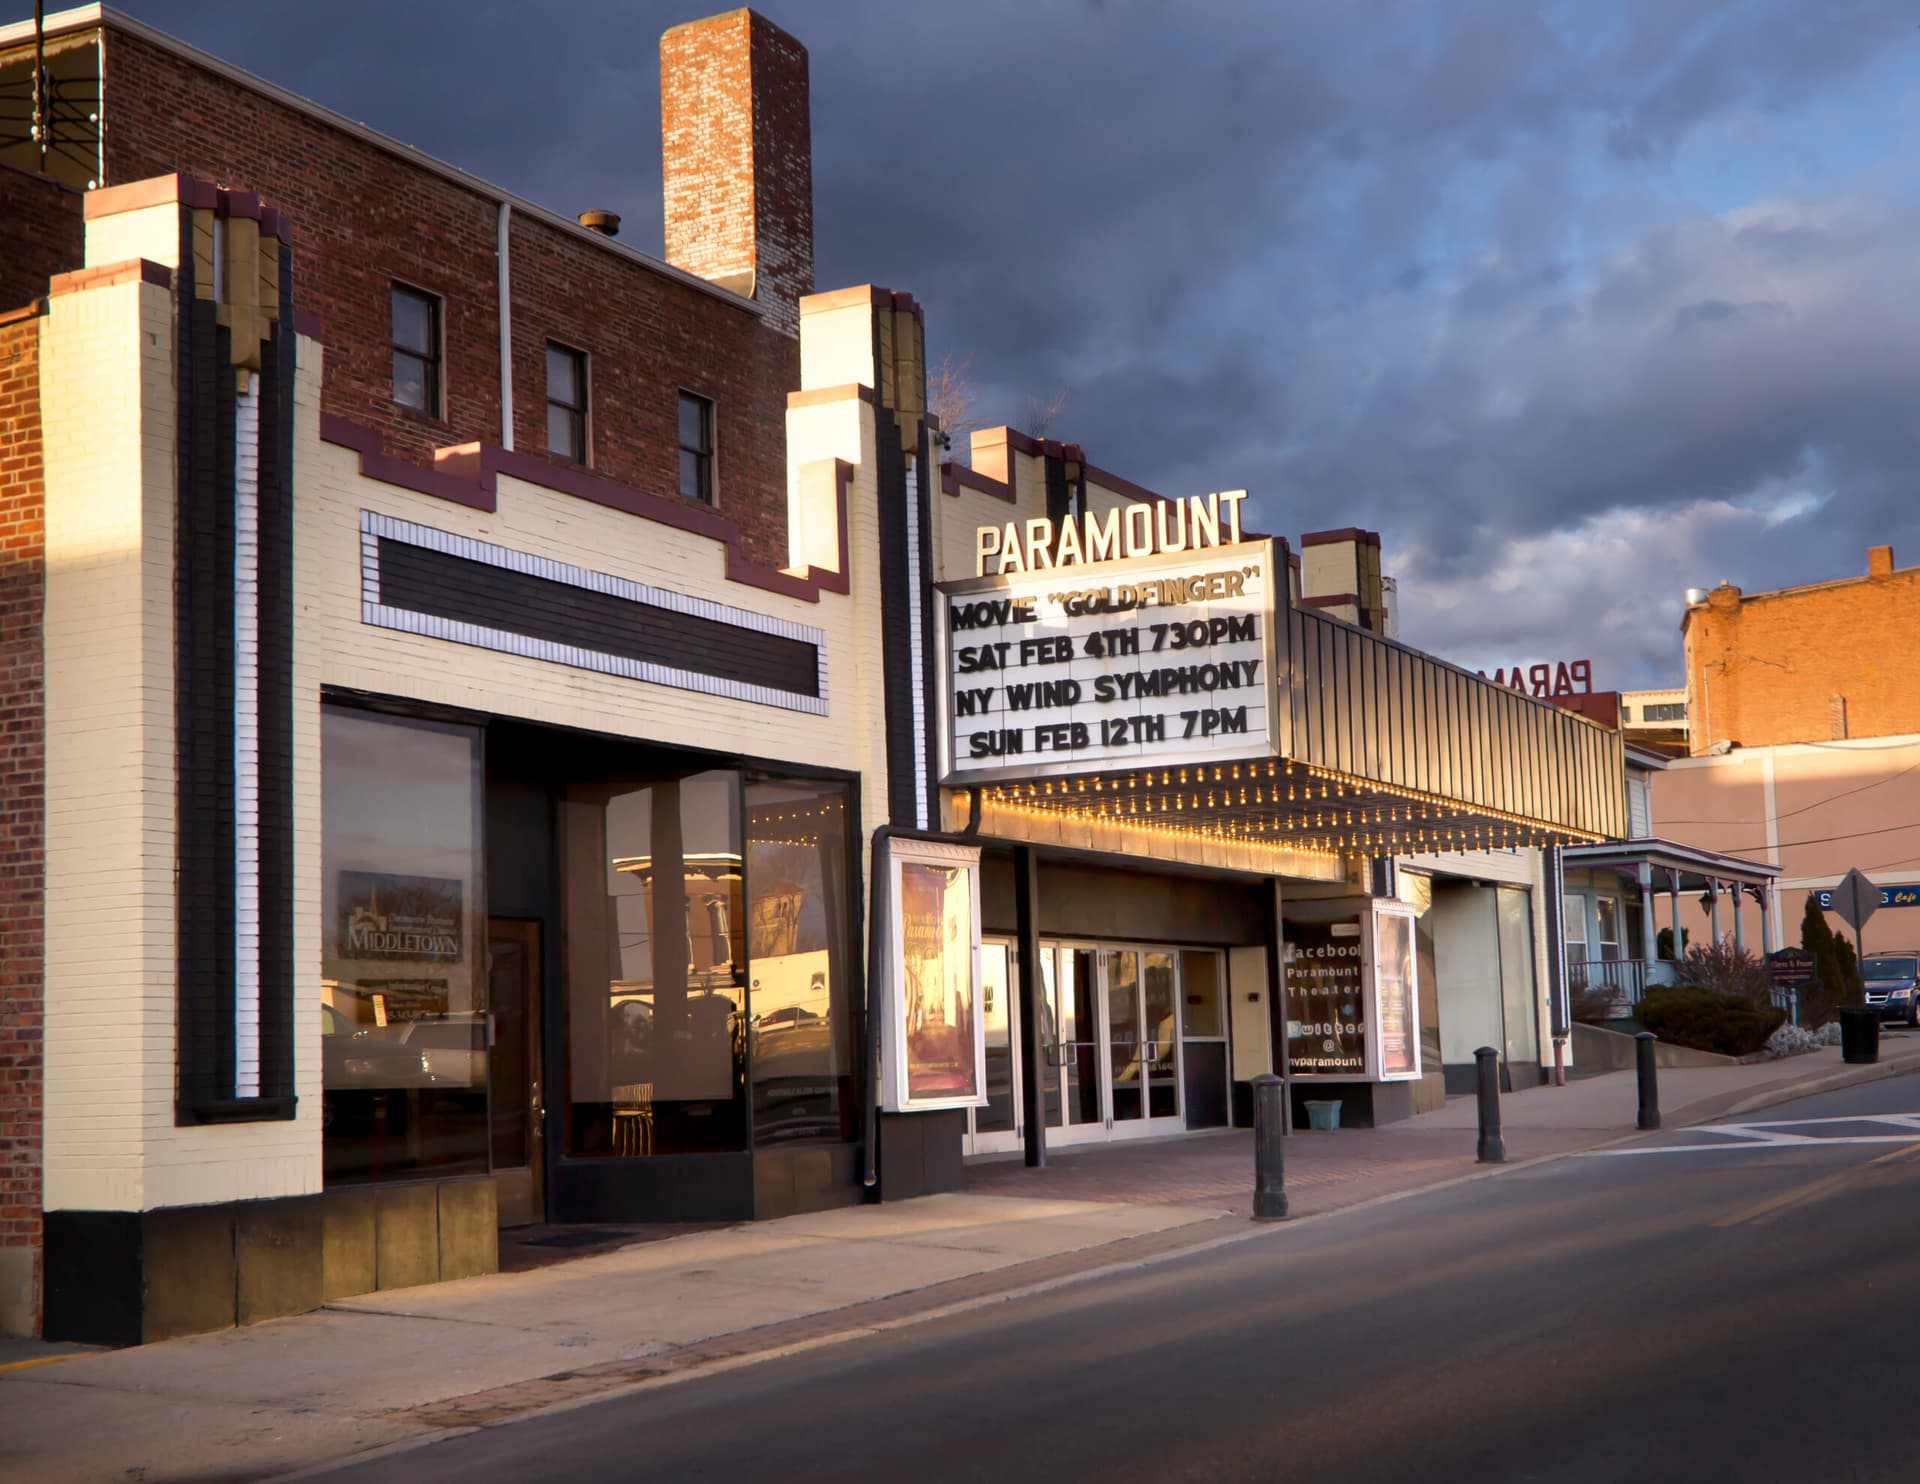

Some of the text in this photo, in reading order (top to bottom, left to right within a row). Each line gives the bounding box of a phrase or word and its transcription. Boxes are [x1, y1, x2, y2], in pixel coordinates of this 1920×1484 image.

[976, 489, 1248, 577] PARAMOUNT
[951, 597, 1037, 631] MOVIE
[958, 613, 1255, 673] SAT FEB 4TH 730PM
[956, 659, 1260, 716] NY WIND SYMPHONY
[969, 705, 1248, 758] SUN FEB 12TH 7PM
[348, 928, 458, 953] MIDDLETOWN
[1287, 966, 1359, 978] Paramount
[1288, 985, 1361, 997] Theater
[1322, 1039, 1335, 1052] @
